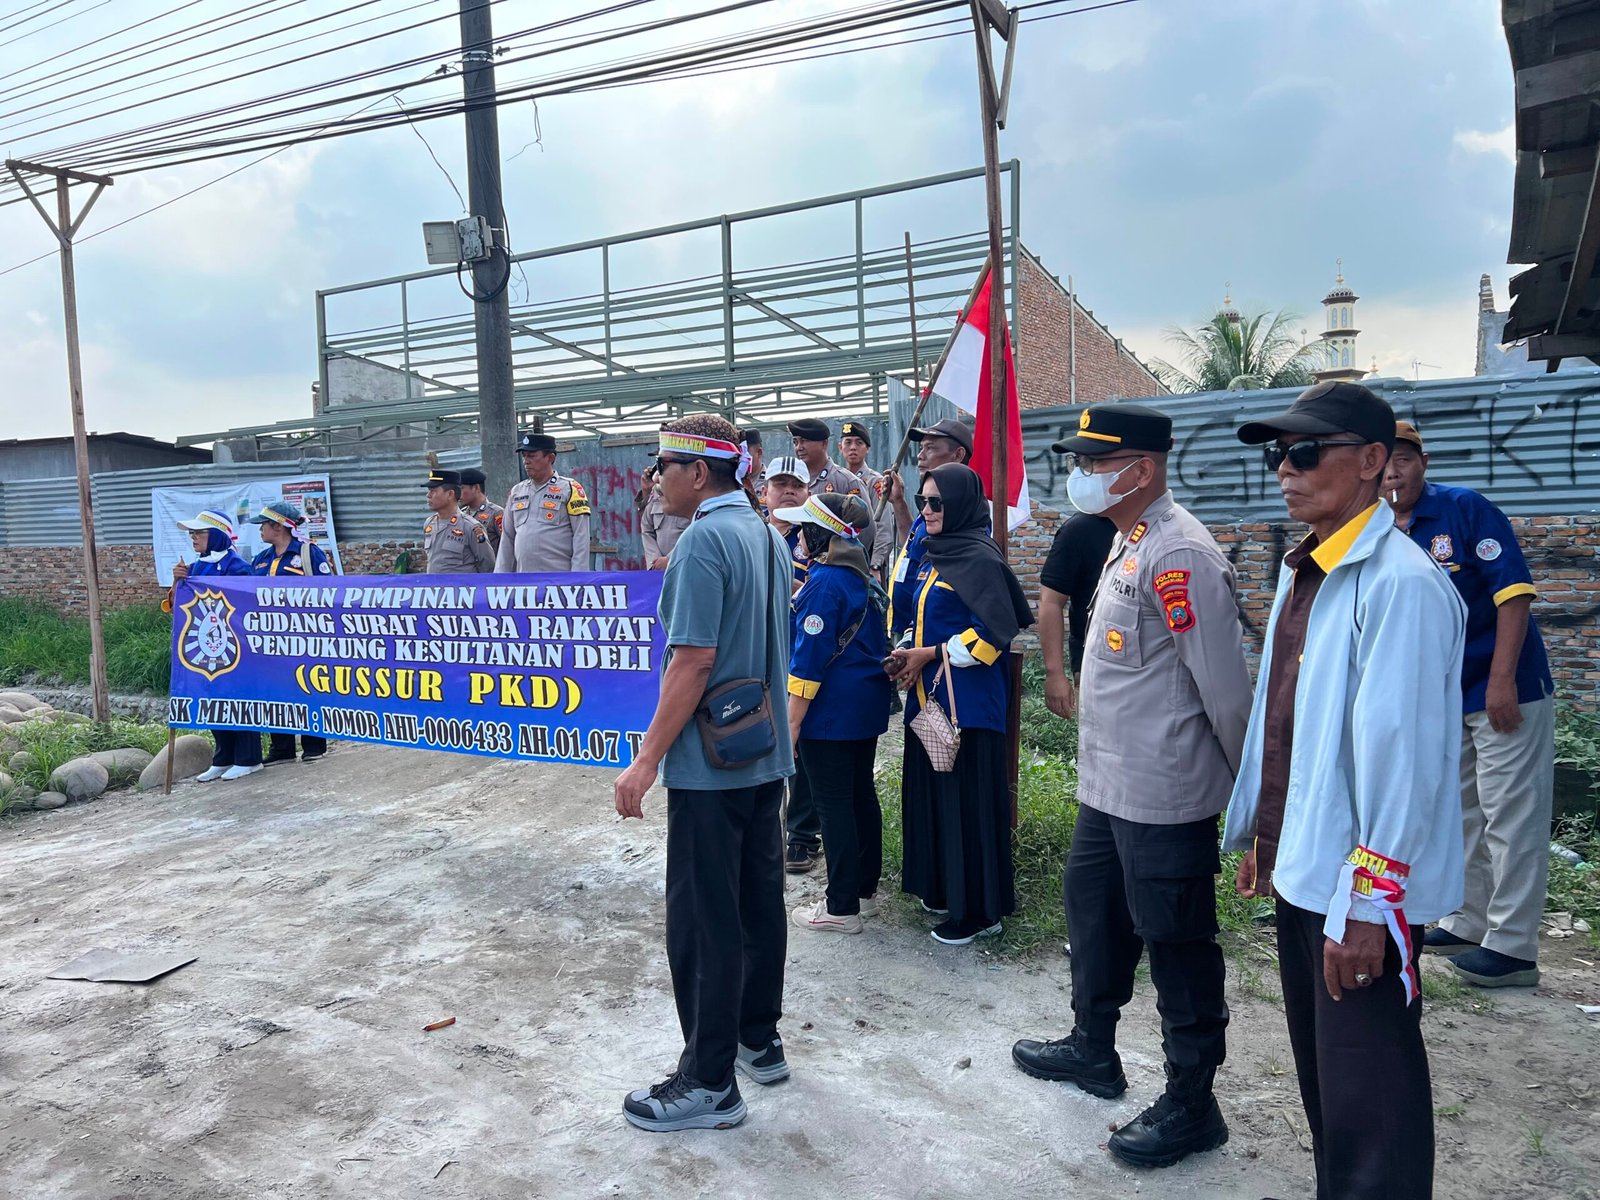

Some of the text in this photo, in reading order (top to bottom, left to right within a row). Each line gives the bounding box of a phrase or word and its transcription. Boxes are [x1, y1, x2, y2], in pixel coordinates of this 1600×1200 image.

[1112, 578, 1137, 599] POLRI
[1155, 572, 1184, 586] POLRES
[256, 584, 628, 611] DEWAN PIMPINAN WILAYAH
[242, 611, 655, 642] GUDANG SURAT SUARA RAKYAT
[245, 635, 652, 671] PENDUKUNG KESULTANAN DELI
[295, 663, 582, 715] (GUSSUR PKD)
[169, 698, 192, 724] SK
[197, 699, 310, 731] MENKUMHAM
[321, 706, 380, 740] NOMOR
[383, 713, 513, 753] AHU-0006433
[518, 724, 621, 763] AH.01.07
